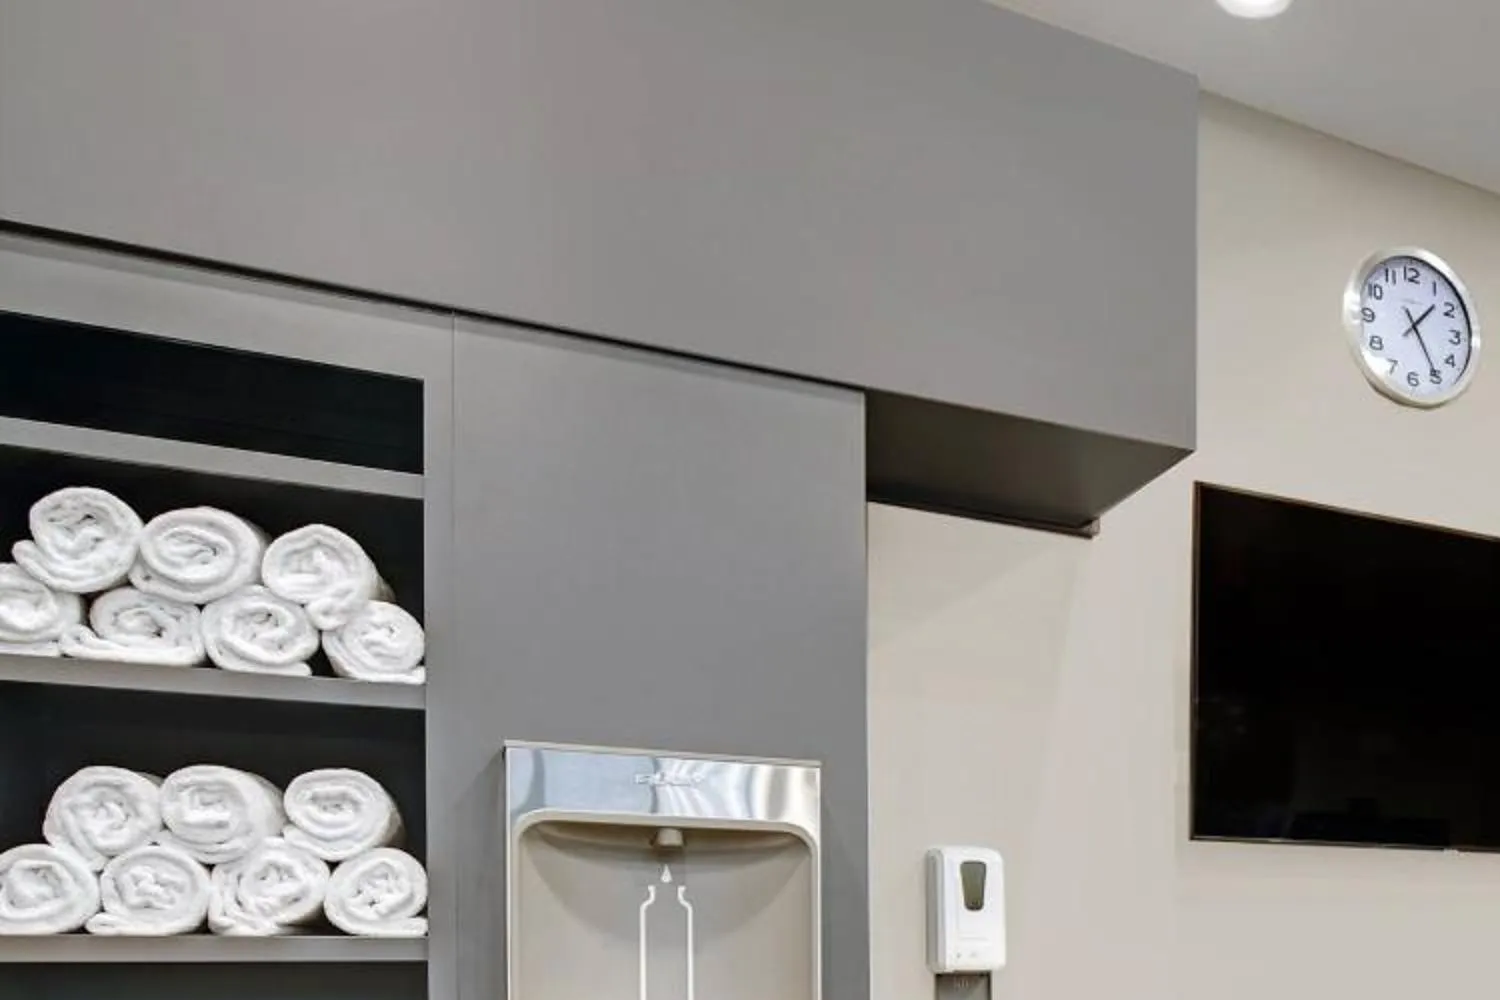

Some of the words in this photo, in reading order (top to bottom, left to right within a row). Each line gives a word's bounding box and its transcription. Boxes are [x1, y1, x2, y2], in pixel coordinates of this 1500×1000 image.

[1384, 267, 1397, 285] 11
[1403, 266, 1421, 284] 12
[1367, 283, 1384, 300] 10
[1432, 281, 1437, 296] 1
[1360, 307, 1375, 323] 9
[1443, 302, 1455, 318] 2
[1369, 335, 1384, 351] 8
[1448, 329, 1461, 345] 3
[1387, 359, 1399, 375] 7
[1444, 355, 1456, 368] 4
[1407, 371, 1419, 387] 6
[1430, 369, 1442, 384] 5
